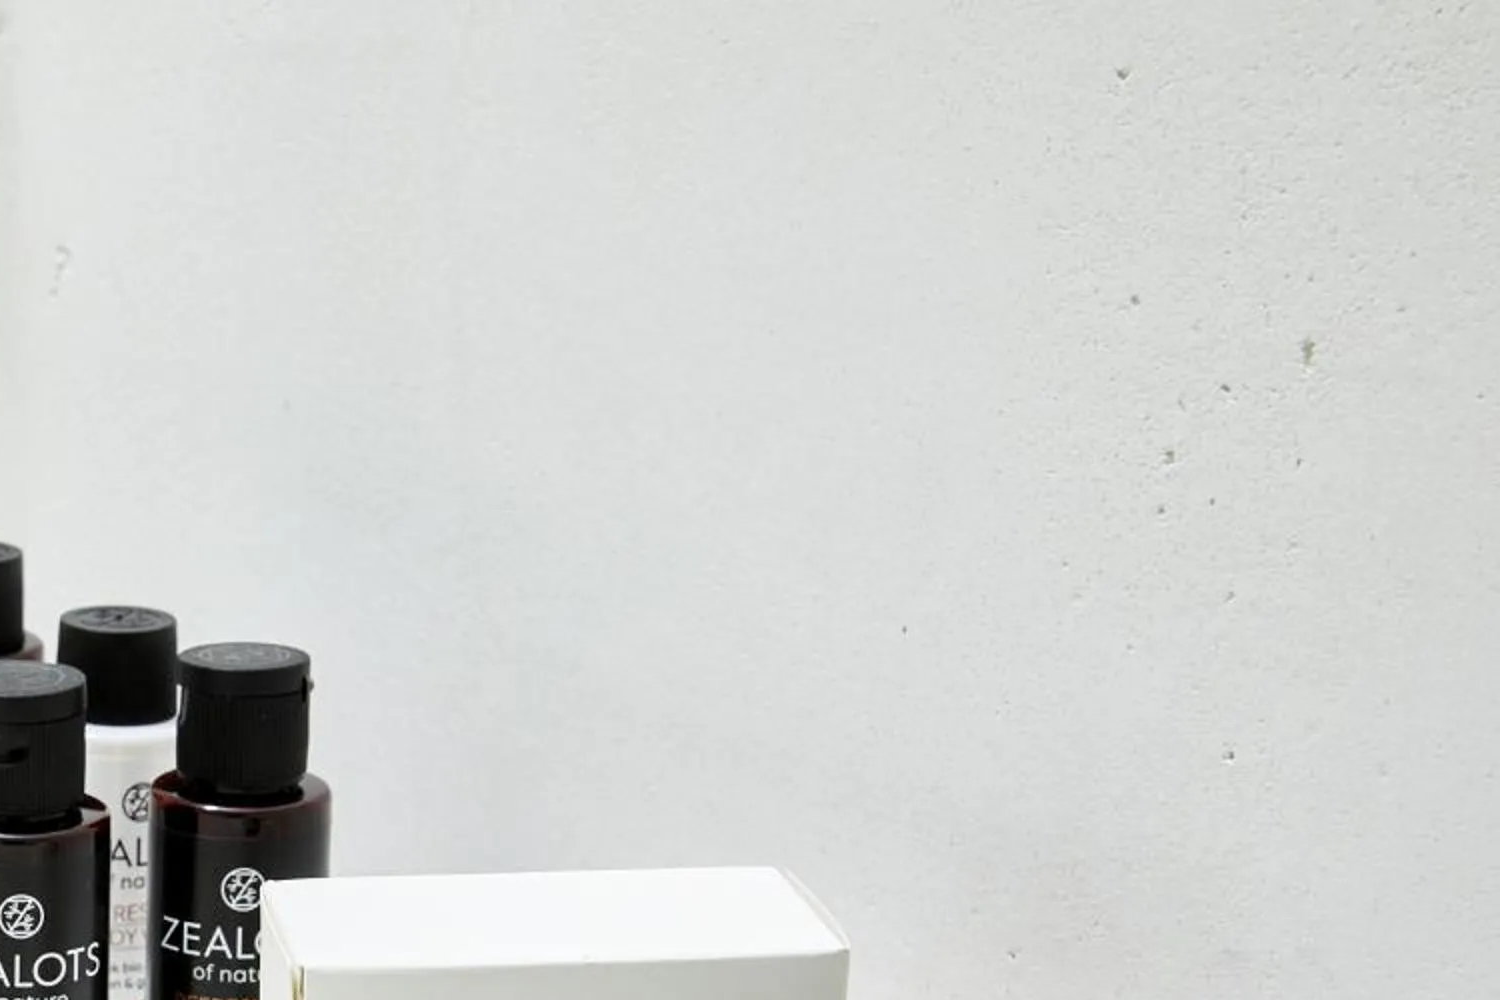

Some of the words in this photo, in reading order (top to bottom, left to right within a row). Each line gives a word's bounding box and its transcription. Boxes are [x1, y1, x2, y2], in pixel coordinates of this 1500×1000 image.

[160, 915, 260, 960] ZEAL
[192, 963, 216, 981] of
[219, 967, 260, 984] nat
